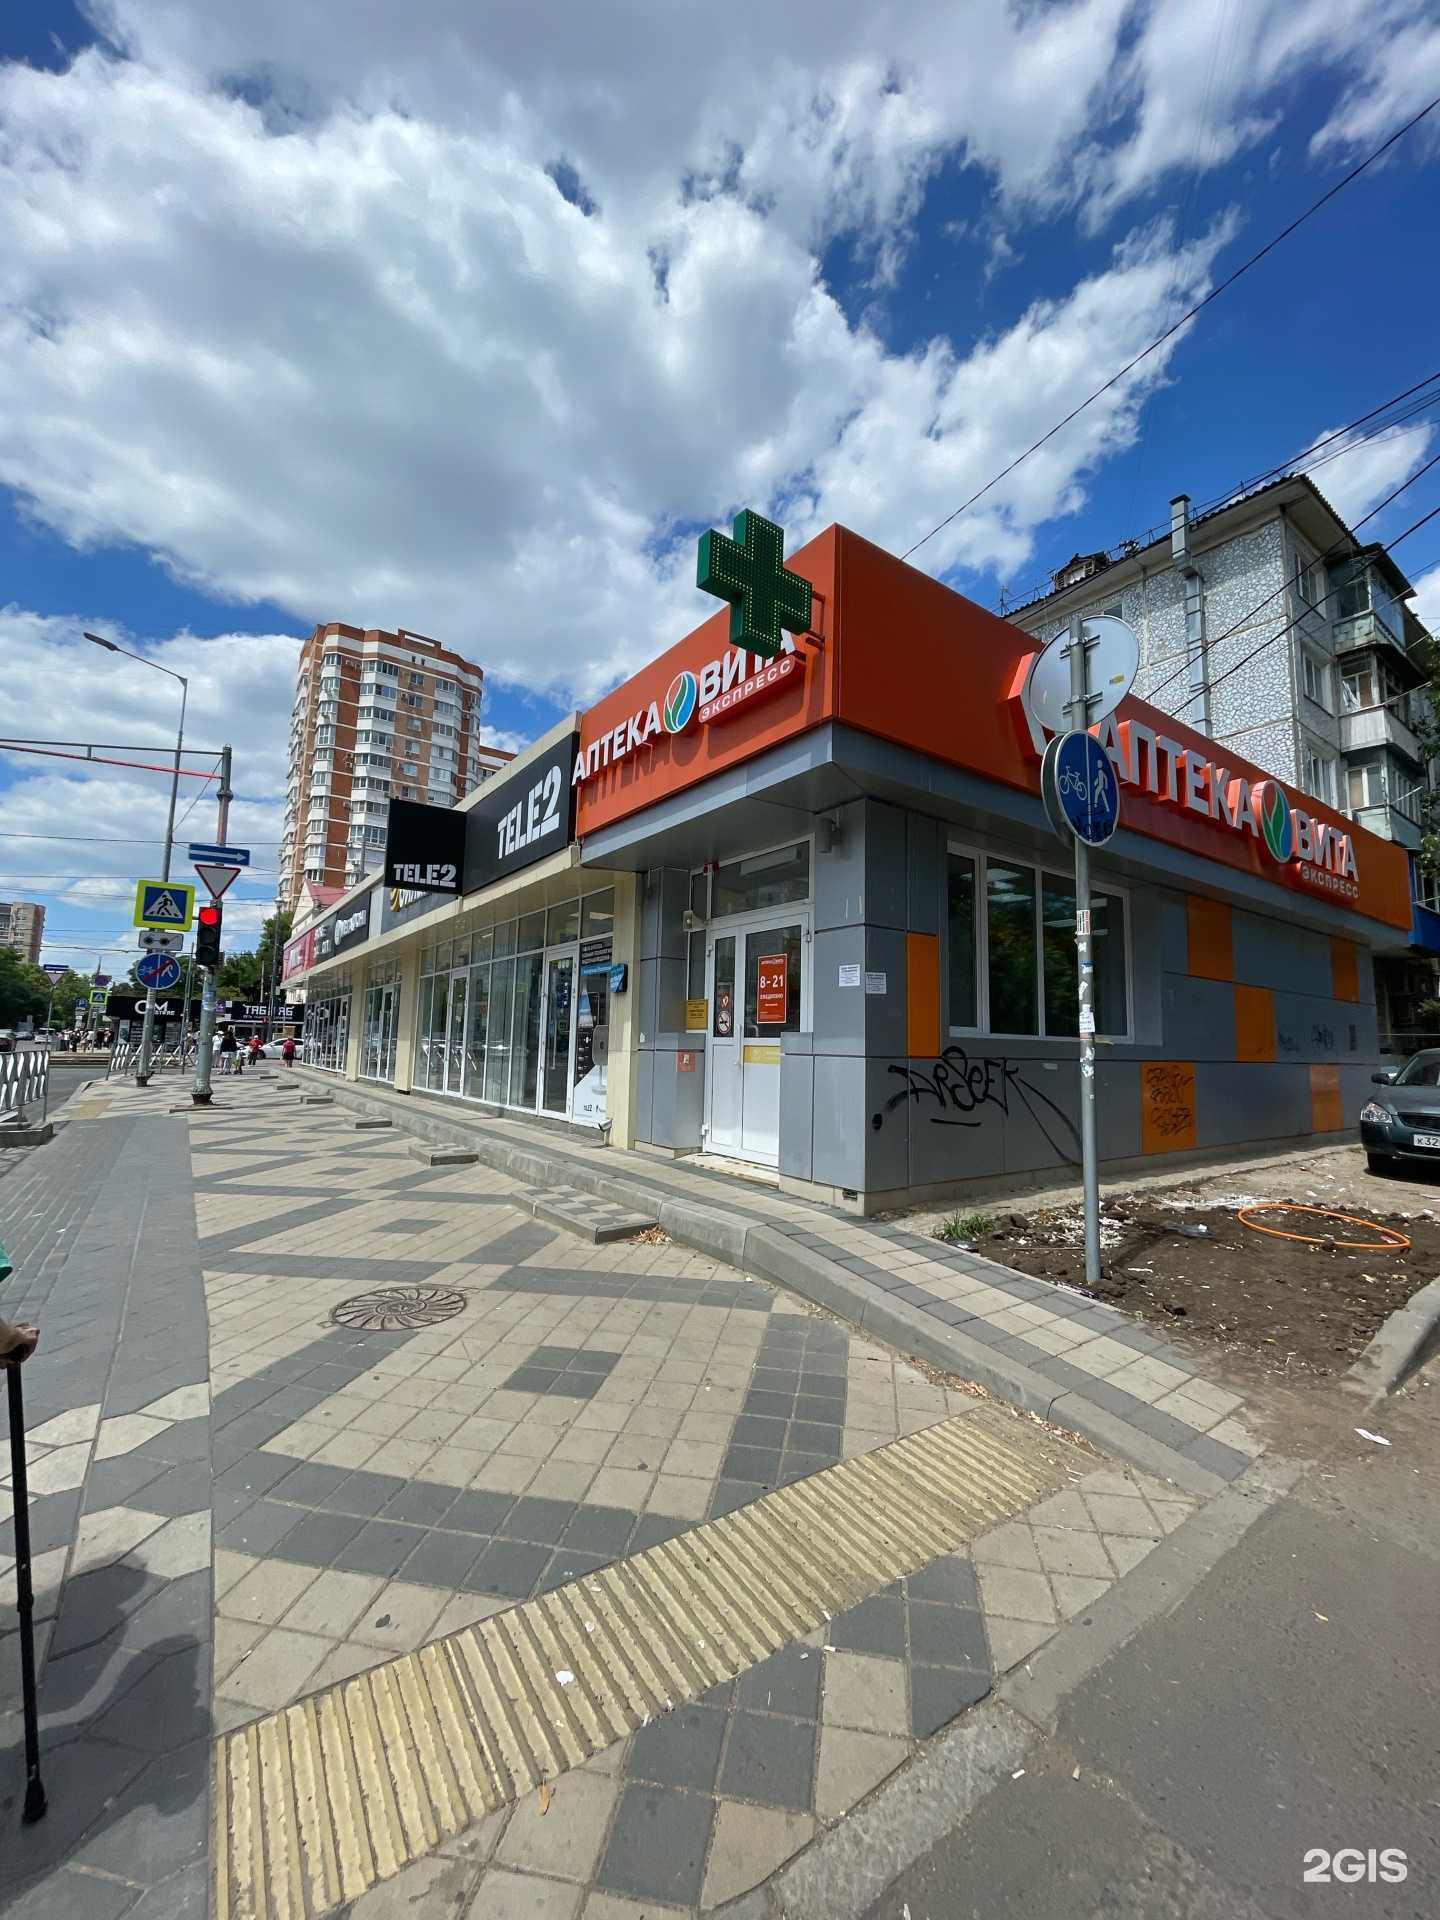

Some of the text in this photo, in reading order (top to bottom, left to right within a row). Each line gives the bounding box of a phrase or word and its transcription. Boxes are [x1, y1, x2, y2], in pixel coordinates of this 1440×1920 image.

[701, 659, 791, 719] ЭКСПРЕСС
[572, 701, 662, 786] АПТЕКА
[497, 765, 562, 859] TELE2
[1098, 711, 1360, 882] АПТЕКА ВИТА
[393, 863, 457, 888] TELE2
[1301, 863, 1360, 899] ЭКСПРЕСС
